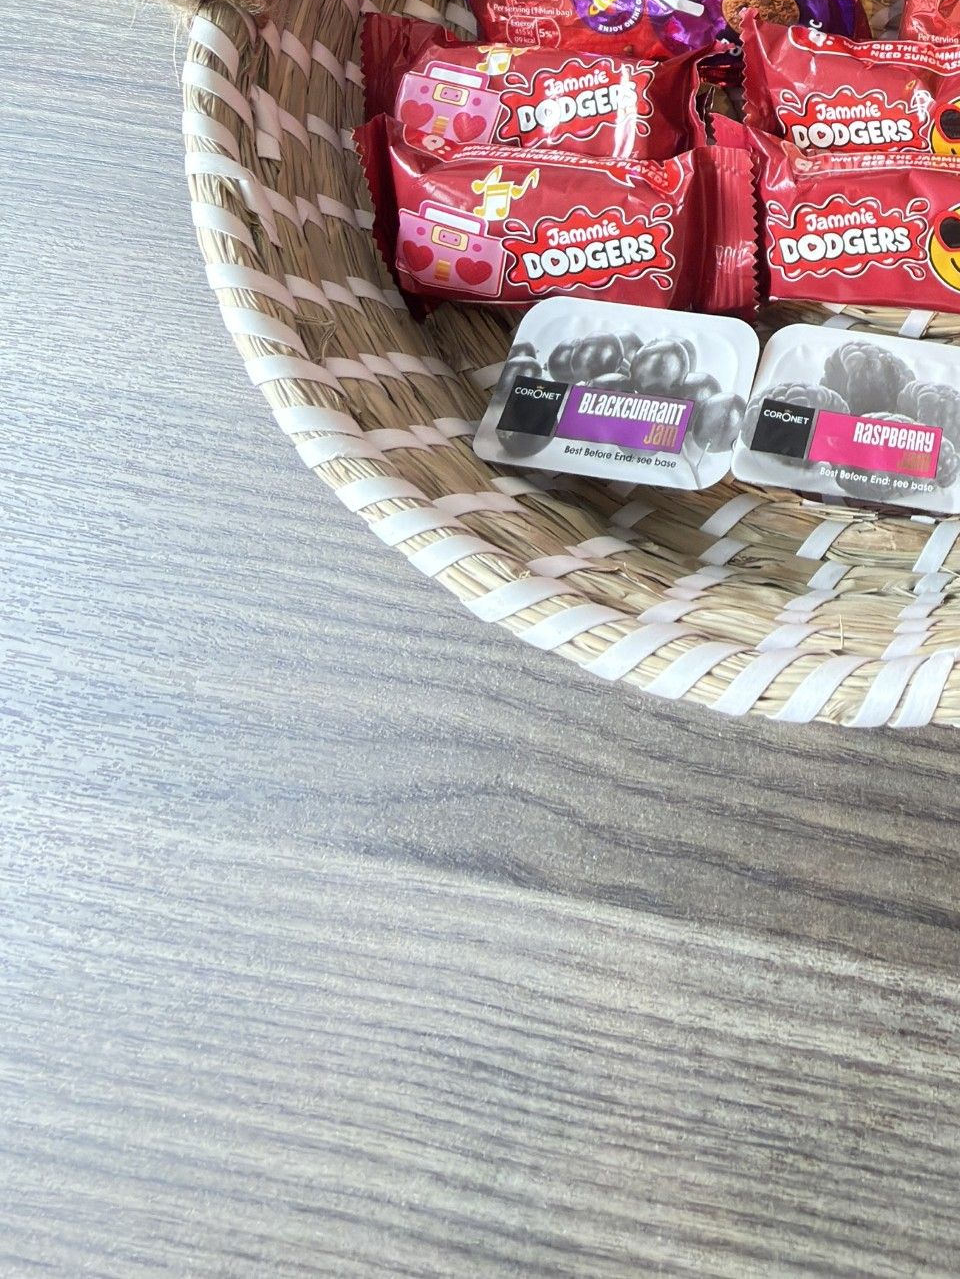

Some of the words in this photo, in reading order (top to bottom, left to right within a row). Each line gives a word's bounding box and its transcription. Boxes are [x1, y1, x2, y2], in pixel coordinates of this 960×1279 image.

[493, 3, 504, 12] Per
[597, 24, 623, 33] ENJOY
[624, 18, 635, 28] ON
[871, 43, 894, 51] DID
[896, 44, 918, 53] THE
[918, 33, 930, 42] Per
[930, 34, 959, 46] serving
[870, 50, 901, 59] NEED
[543, 69, 609, 97] Jammie
[516, 81, 638, 132] DODGERS
[816, 101, 881, 121] Jammie
[791, 119, 914, 149] DODGERS
[804, 208, 877, 232] Jammie
[547, 220, 621, 246] Jammie
[779, 226, 912, 264] DODGERS
[522, 233, 656, 279] DODGERS
[514, 385, 562, 401] CORONET
[763, 409, 810, 425] CORONET
[564, 445, 583, 456] Best
[585, 447, 612, 460] Before
[615, 451, 635, 462] End:
[636, 456, 652, 465] see
[654, 457, 677, 469] base
[819, 466, 839, 478] Best
[840, 469, 868, 483] Before
[870, 476, 891, 486] End:
[893, 479, 908, 489] see
[911, 481, 935, 493] base
